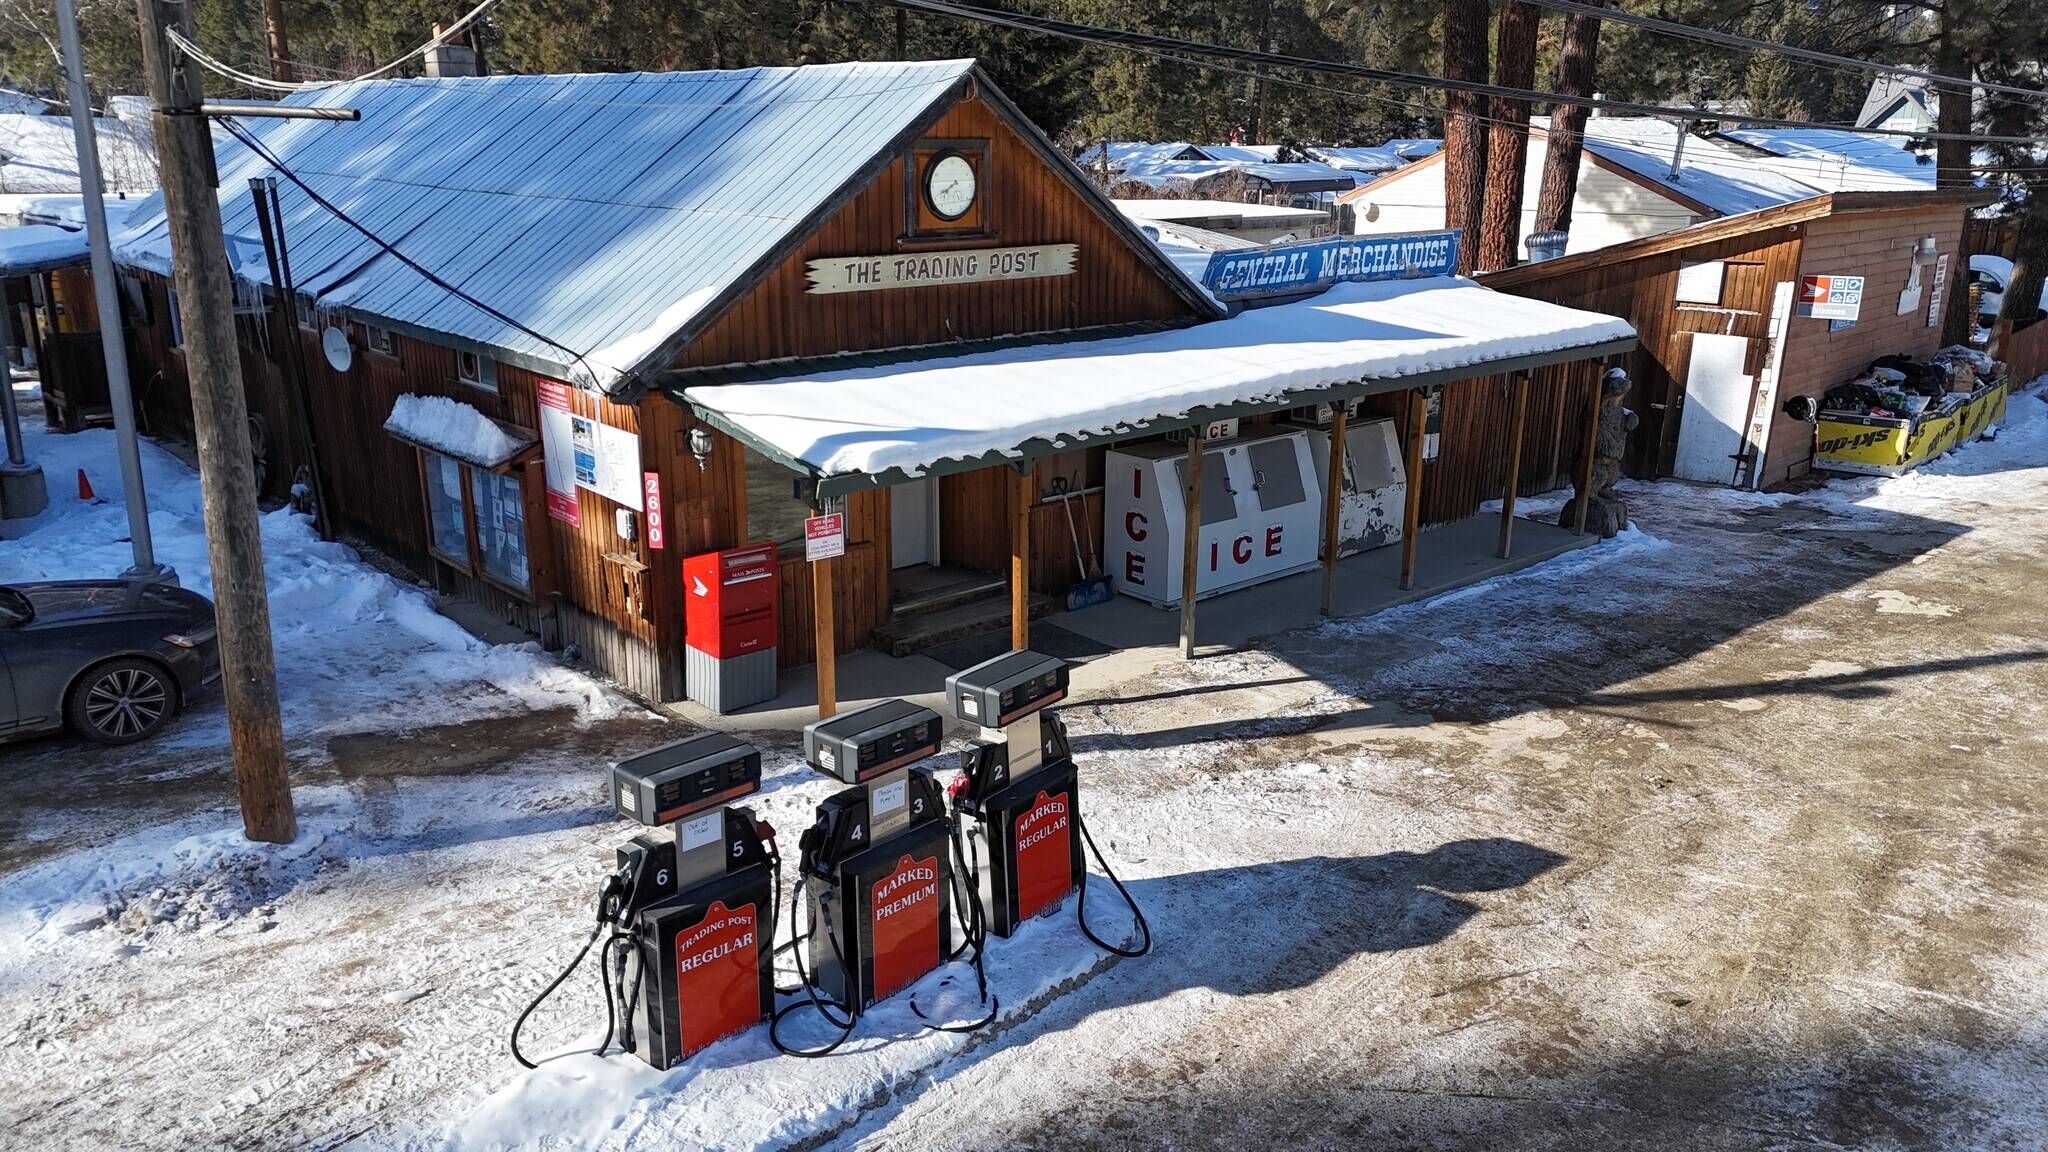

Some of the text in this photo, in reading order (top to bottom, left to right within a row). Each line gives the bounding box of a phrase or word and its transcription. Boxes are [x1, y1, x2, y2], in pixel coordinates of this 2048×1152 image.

[844, 250, 1041, 285] THE TRADING POST
[1219, 239, 1450, 290] GENERAL MERCHANDISE
[1209, 423, 1229, 439] CE
[646, 479, 661, 542] 2600
[1125, 463, 1149, 586] ICE
[1210, 522, 1284, 572] ICE
[1045, 740, 1053, 754] 1
[994, 764, 1004, 781] 2
[913, 798, 924, 814] 3
[1020, 802, 1065, 837] MARKED
[732, 840, 744, 858] 5
[851, 824, 863, 840] 4
[1019, 816, 1067, 852] REGULAR
[656, 868, 668, 885] 6
[877, 867, 934, 905] MARKED
[876, 883, 935, 921] PREMIUM
[680, 916, 753, 953] TRADING POST
[681, 932, 754, 973] REGULAR
